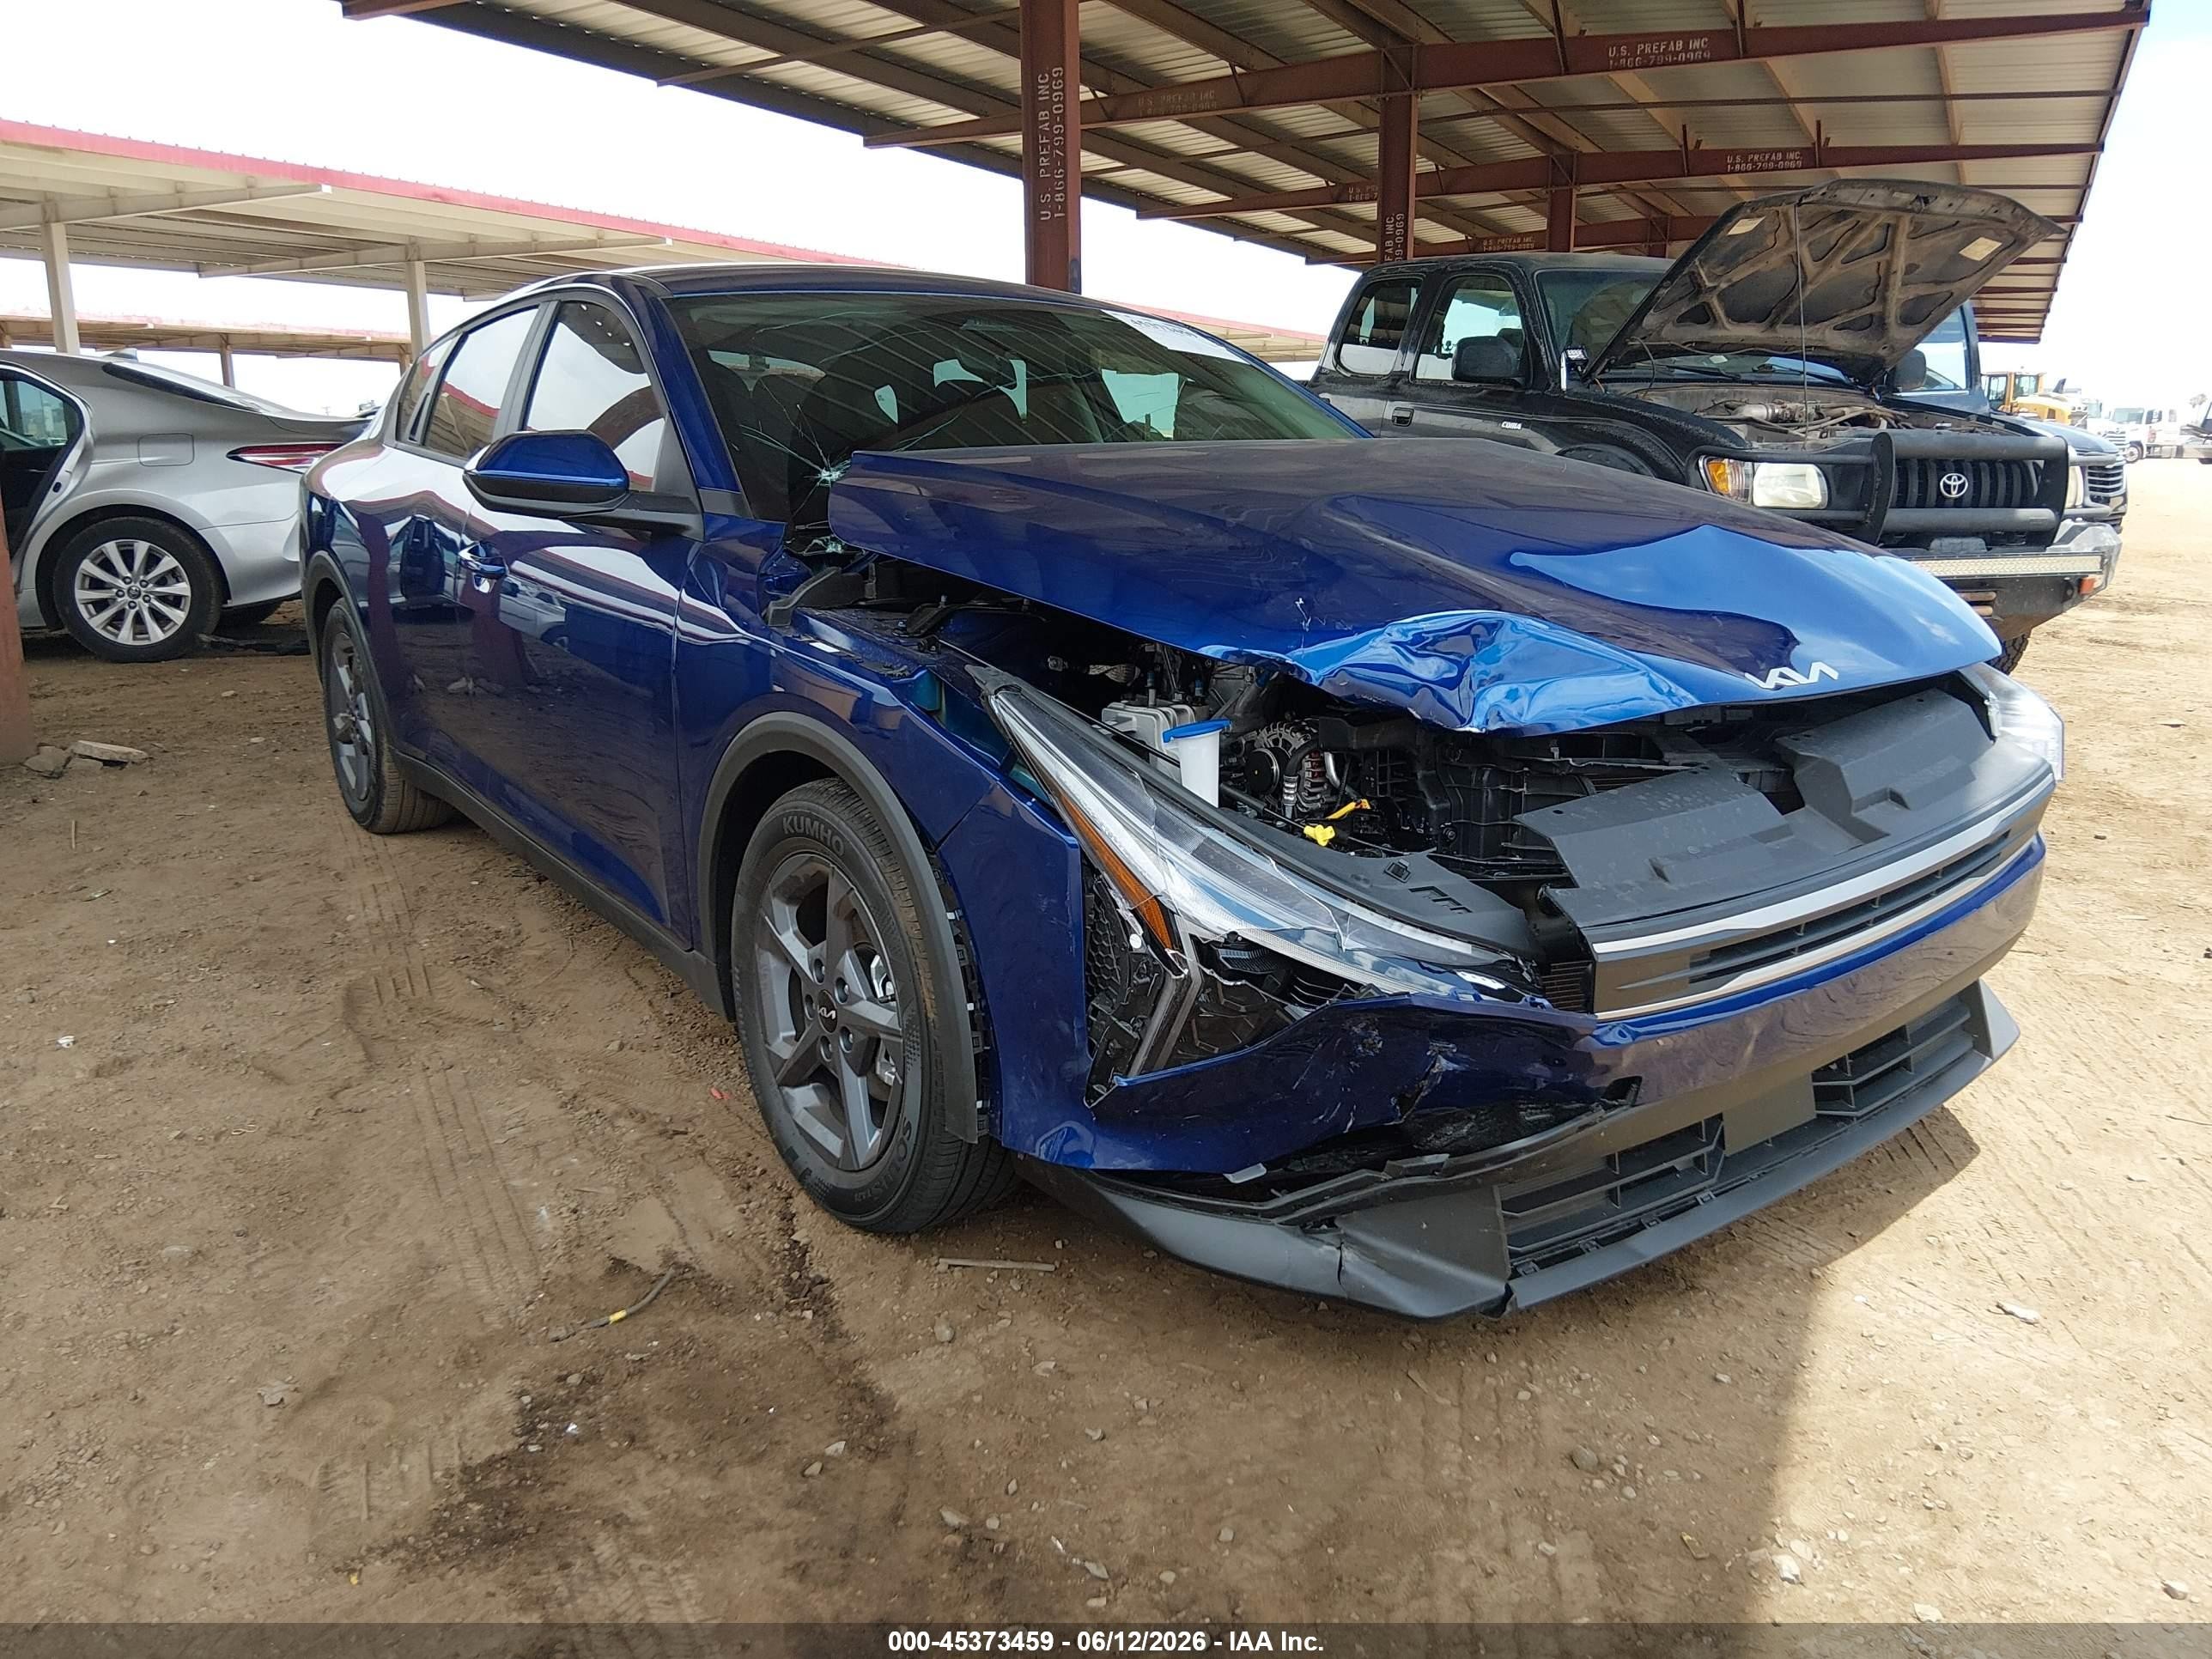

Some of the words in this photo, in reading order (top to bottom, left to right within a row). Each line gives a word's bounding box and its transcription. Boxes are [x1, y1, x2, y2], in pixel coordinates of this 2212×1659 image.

[1608, 45, 1631, 58] U.S.
[1637, 40, 1683, 55] PREFAB
[1038, 110, 1051, 179] PREFAB
[1052, 66, 1066, 219] 1-866-799-0969
[1747, 152, 1782, 162] PREFAB
[1039, 187, 1052, 221] U.S.
[1384, 239, 1394, 262] FAB
[782, 815, 845, 857] KUMHO
